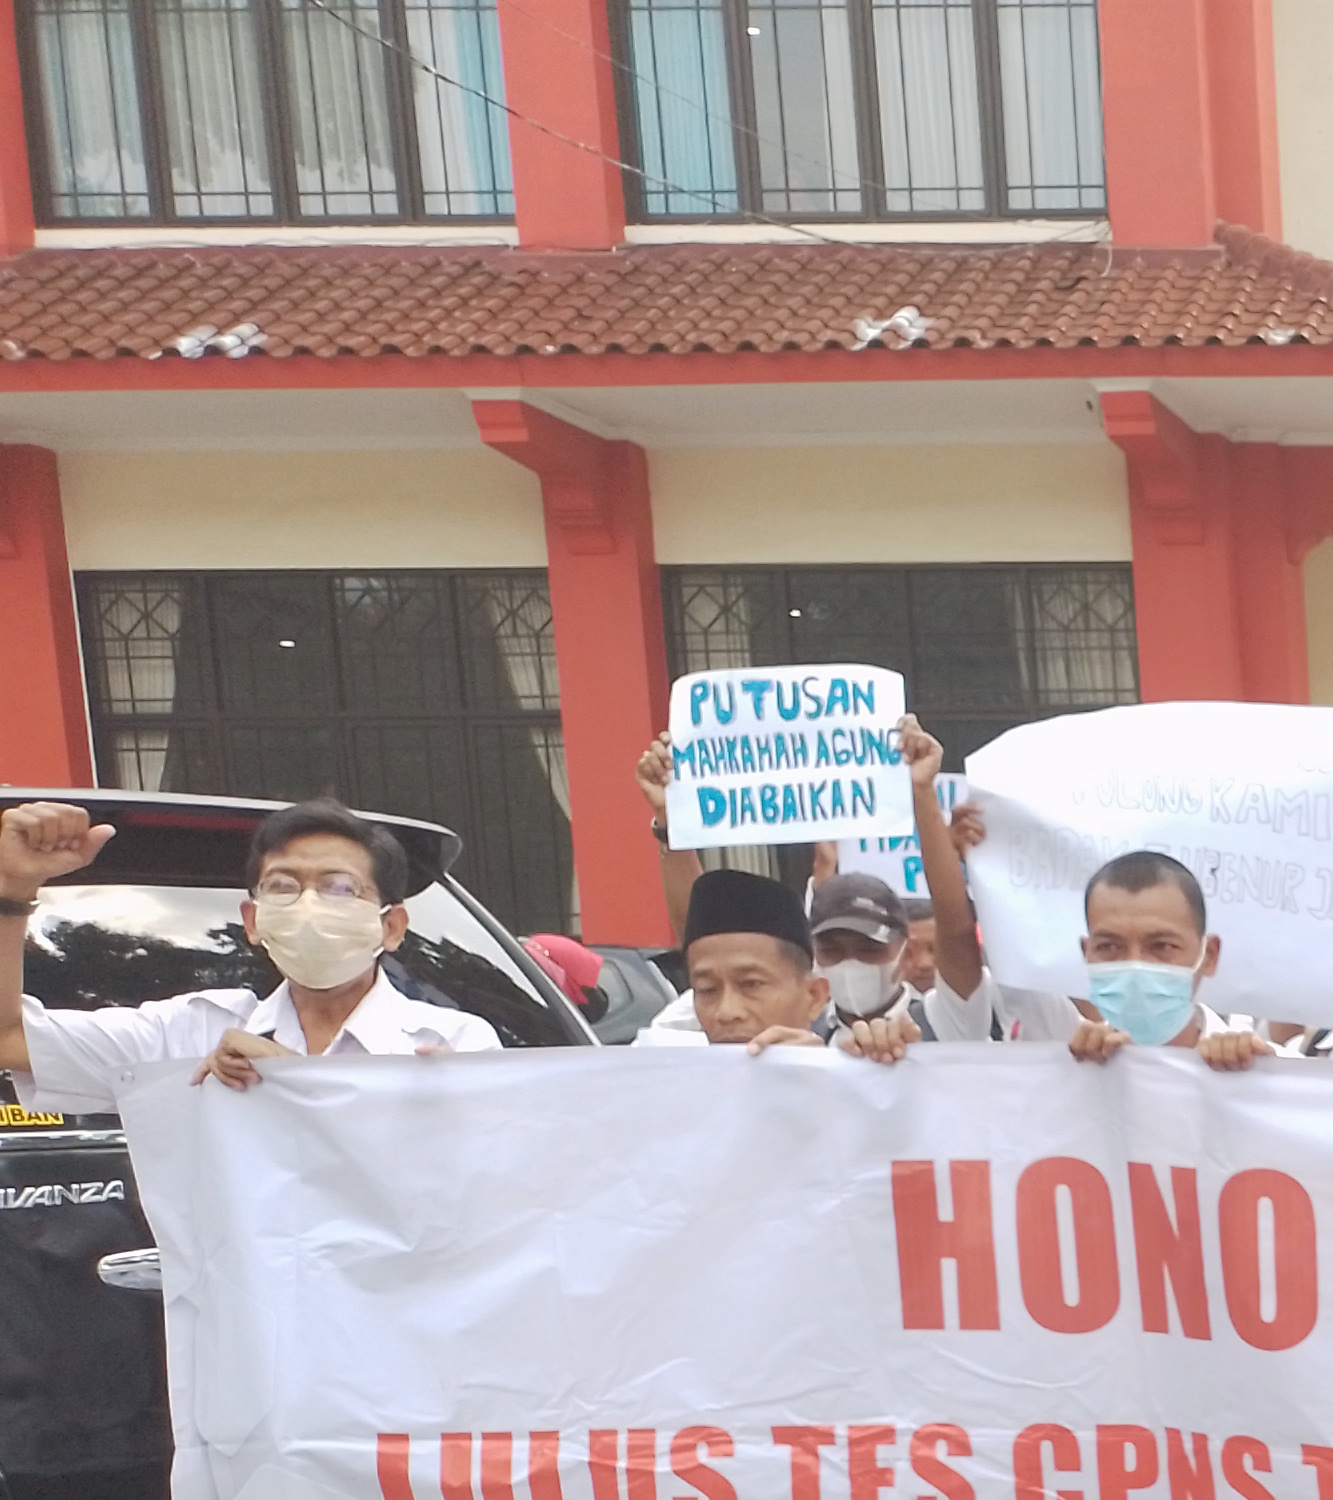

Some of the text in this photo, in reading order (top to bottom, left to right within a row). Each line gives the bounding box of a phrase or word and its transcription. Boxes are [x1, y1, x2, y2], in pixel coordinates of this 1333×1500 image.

[689, 676, 876, 727] PUTUSAN
[815, 727, 902, 769] AGUNG
[697, 777, 876, 829] DIABAIKAN
[1209, 776, 1332, 842] KAMI
[1145, 842, 1306, 915] UBENUR
